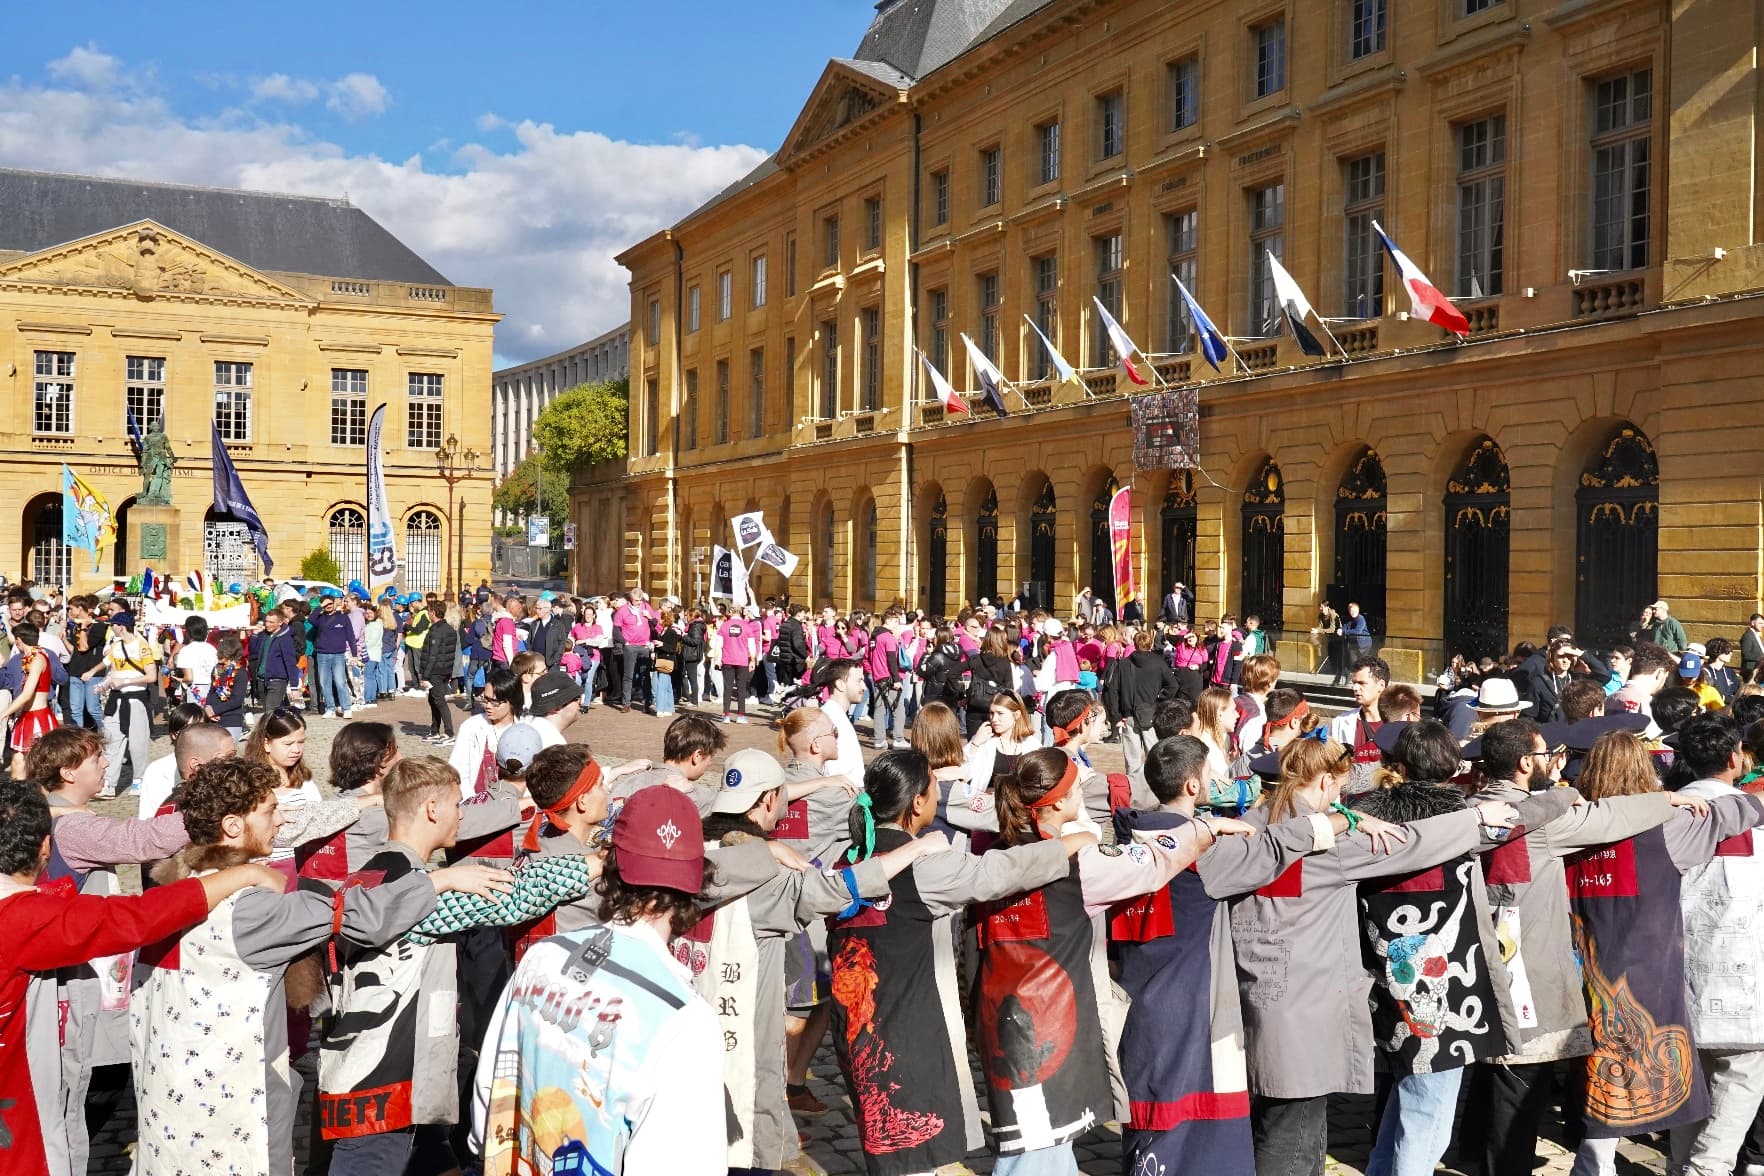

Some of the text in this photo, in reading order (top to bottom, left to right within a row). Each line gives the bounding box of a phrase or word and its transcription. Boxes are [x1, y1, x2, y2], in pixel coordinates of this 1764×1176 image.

[90, 466, 123, 474] OFFICE
[205, 529, 241, 538] OFFICE
[206, 541, 220, 549] DE
[207, 552, 257, 561] TOURISME
